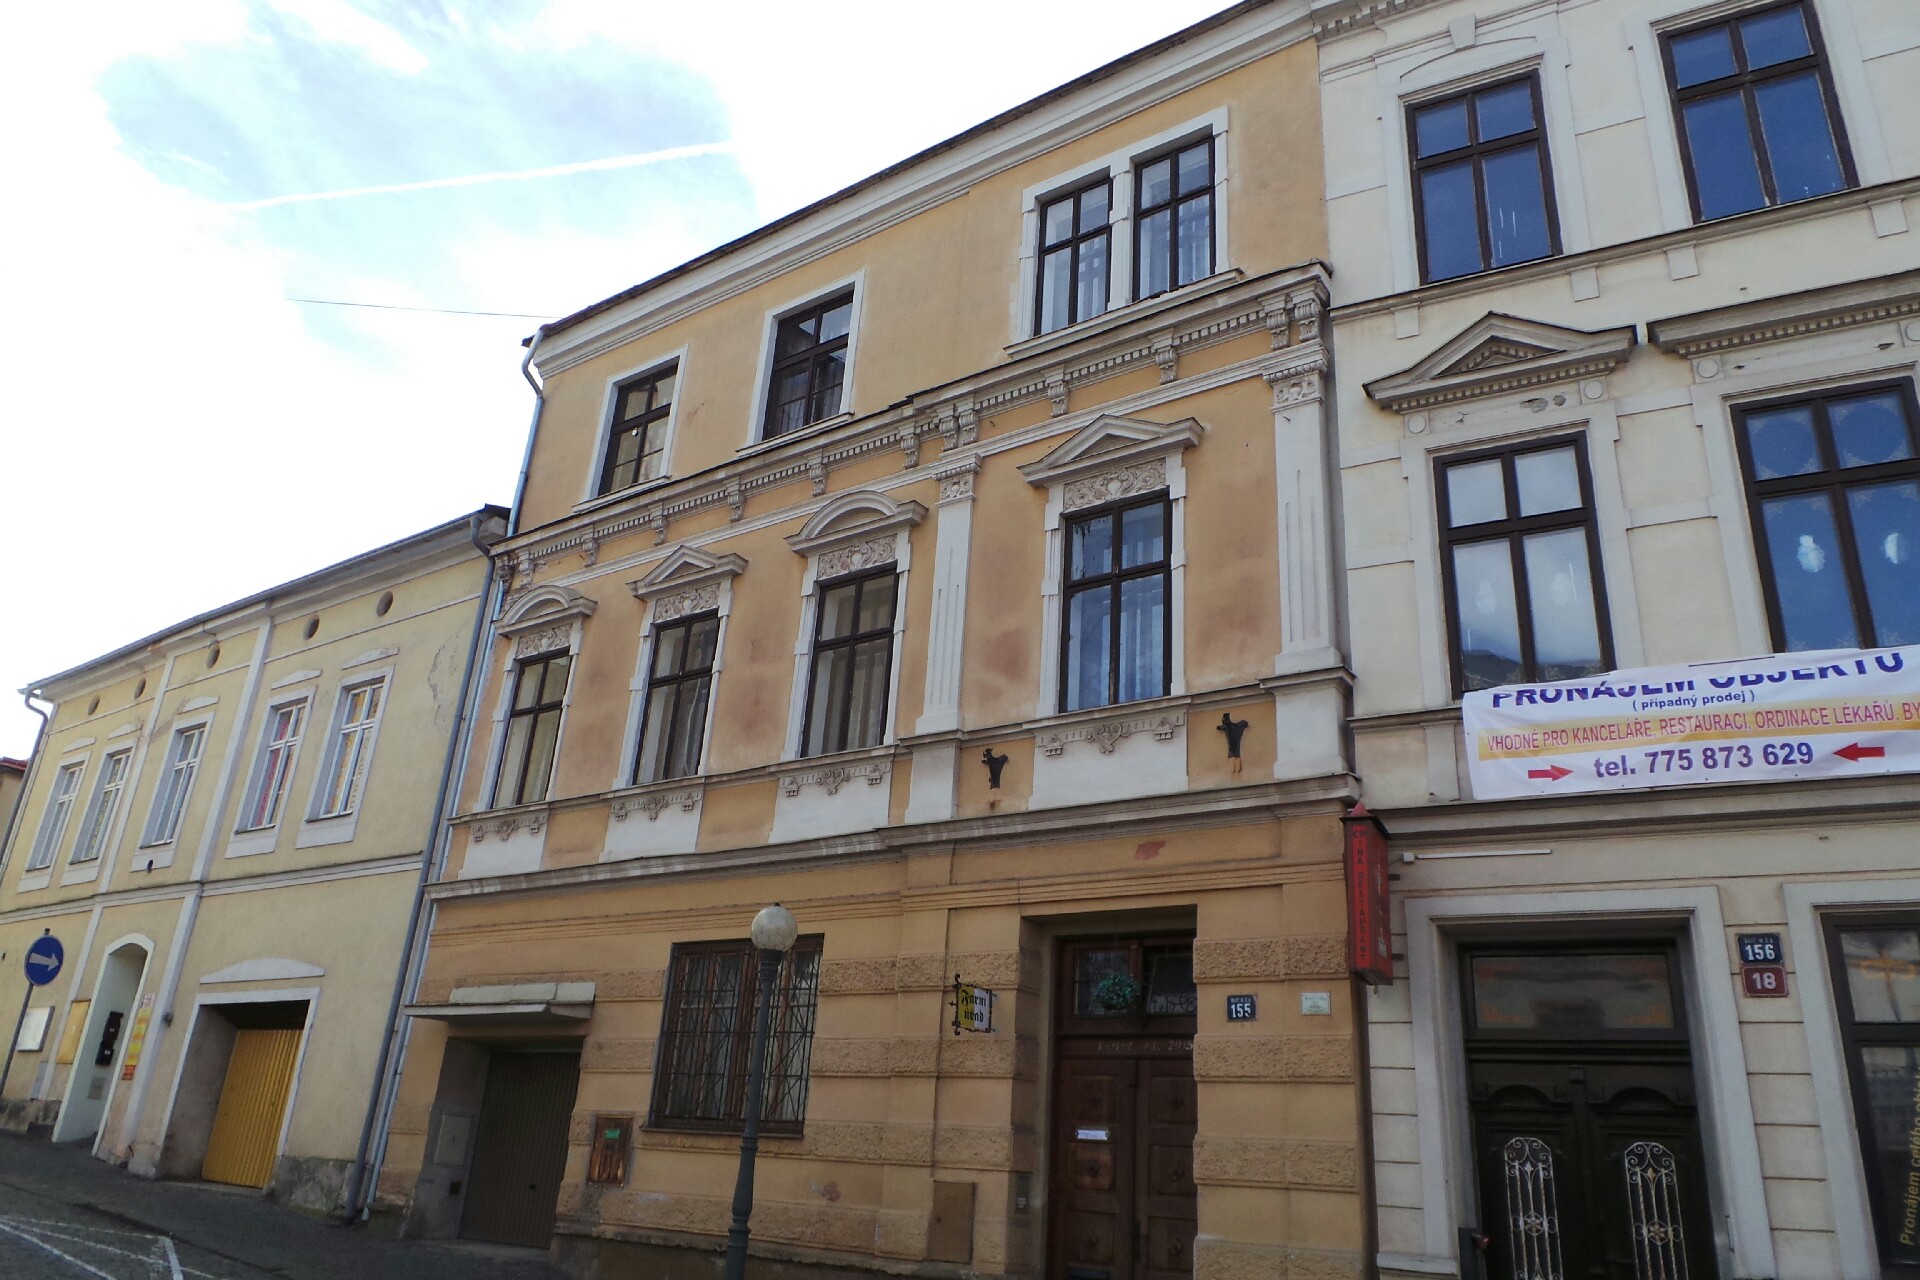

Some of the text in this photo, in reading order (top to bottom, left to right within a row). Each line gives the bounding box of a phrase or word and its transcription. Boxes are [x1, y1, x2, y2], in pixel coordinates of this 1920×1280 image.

[1702, 690, 1746, 707] prodej
[1487, 729, 1539, 751] VHODNÉ
[1543, 731, 1569, 747] PRO
[1755, 707, 1829, 729] ORDINACE
[1594, 742, 1814, 778] tel. 775 873 629
[1357, 872, 1367, 961] RESTAURANT
[1745, 944, 1775, 960] 156
[1752, 972, 1777, 989] 18
[1231, 1003, 1251, 1018] 155
[1899, 1171, 1920, 1246] Pronájem
